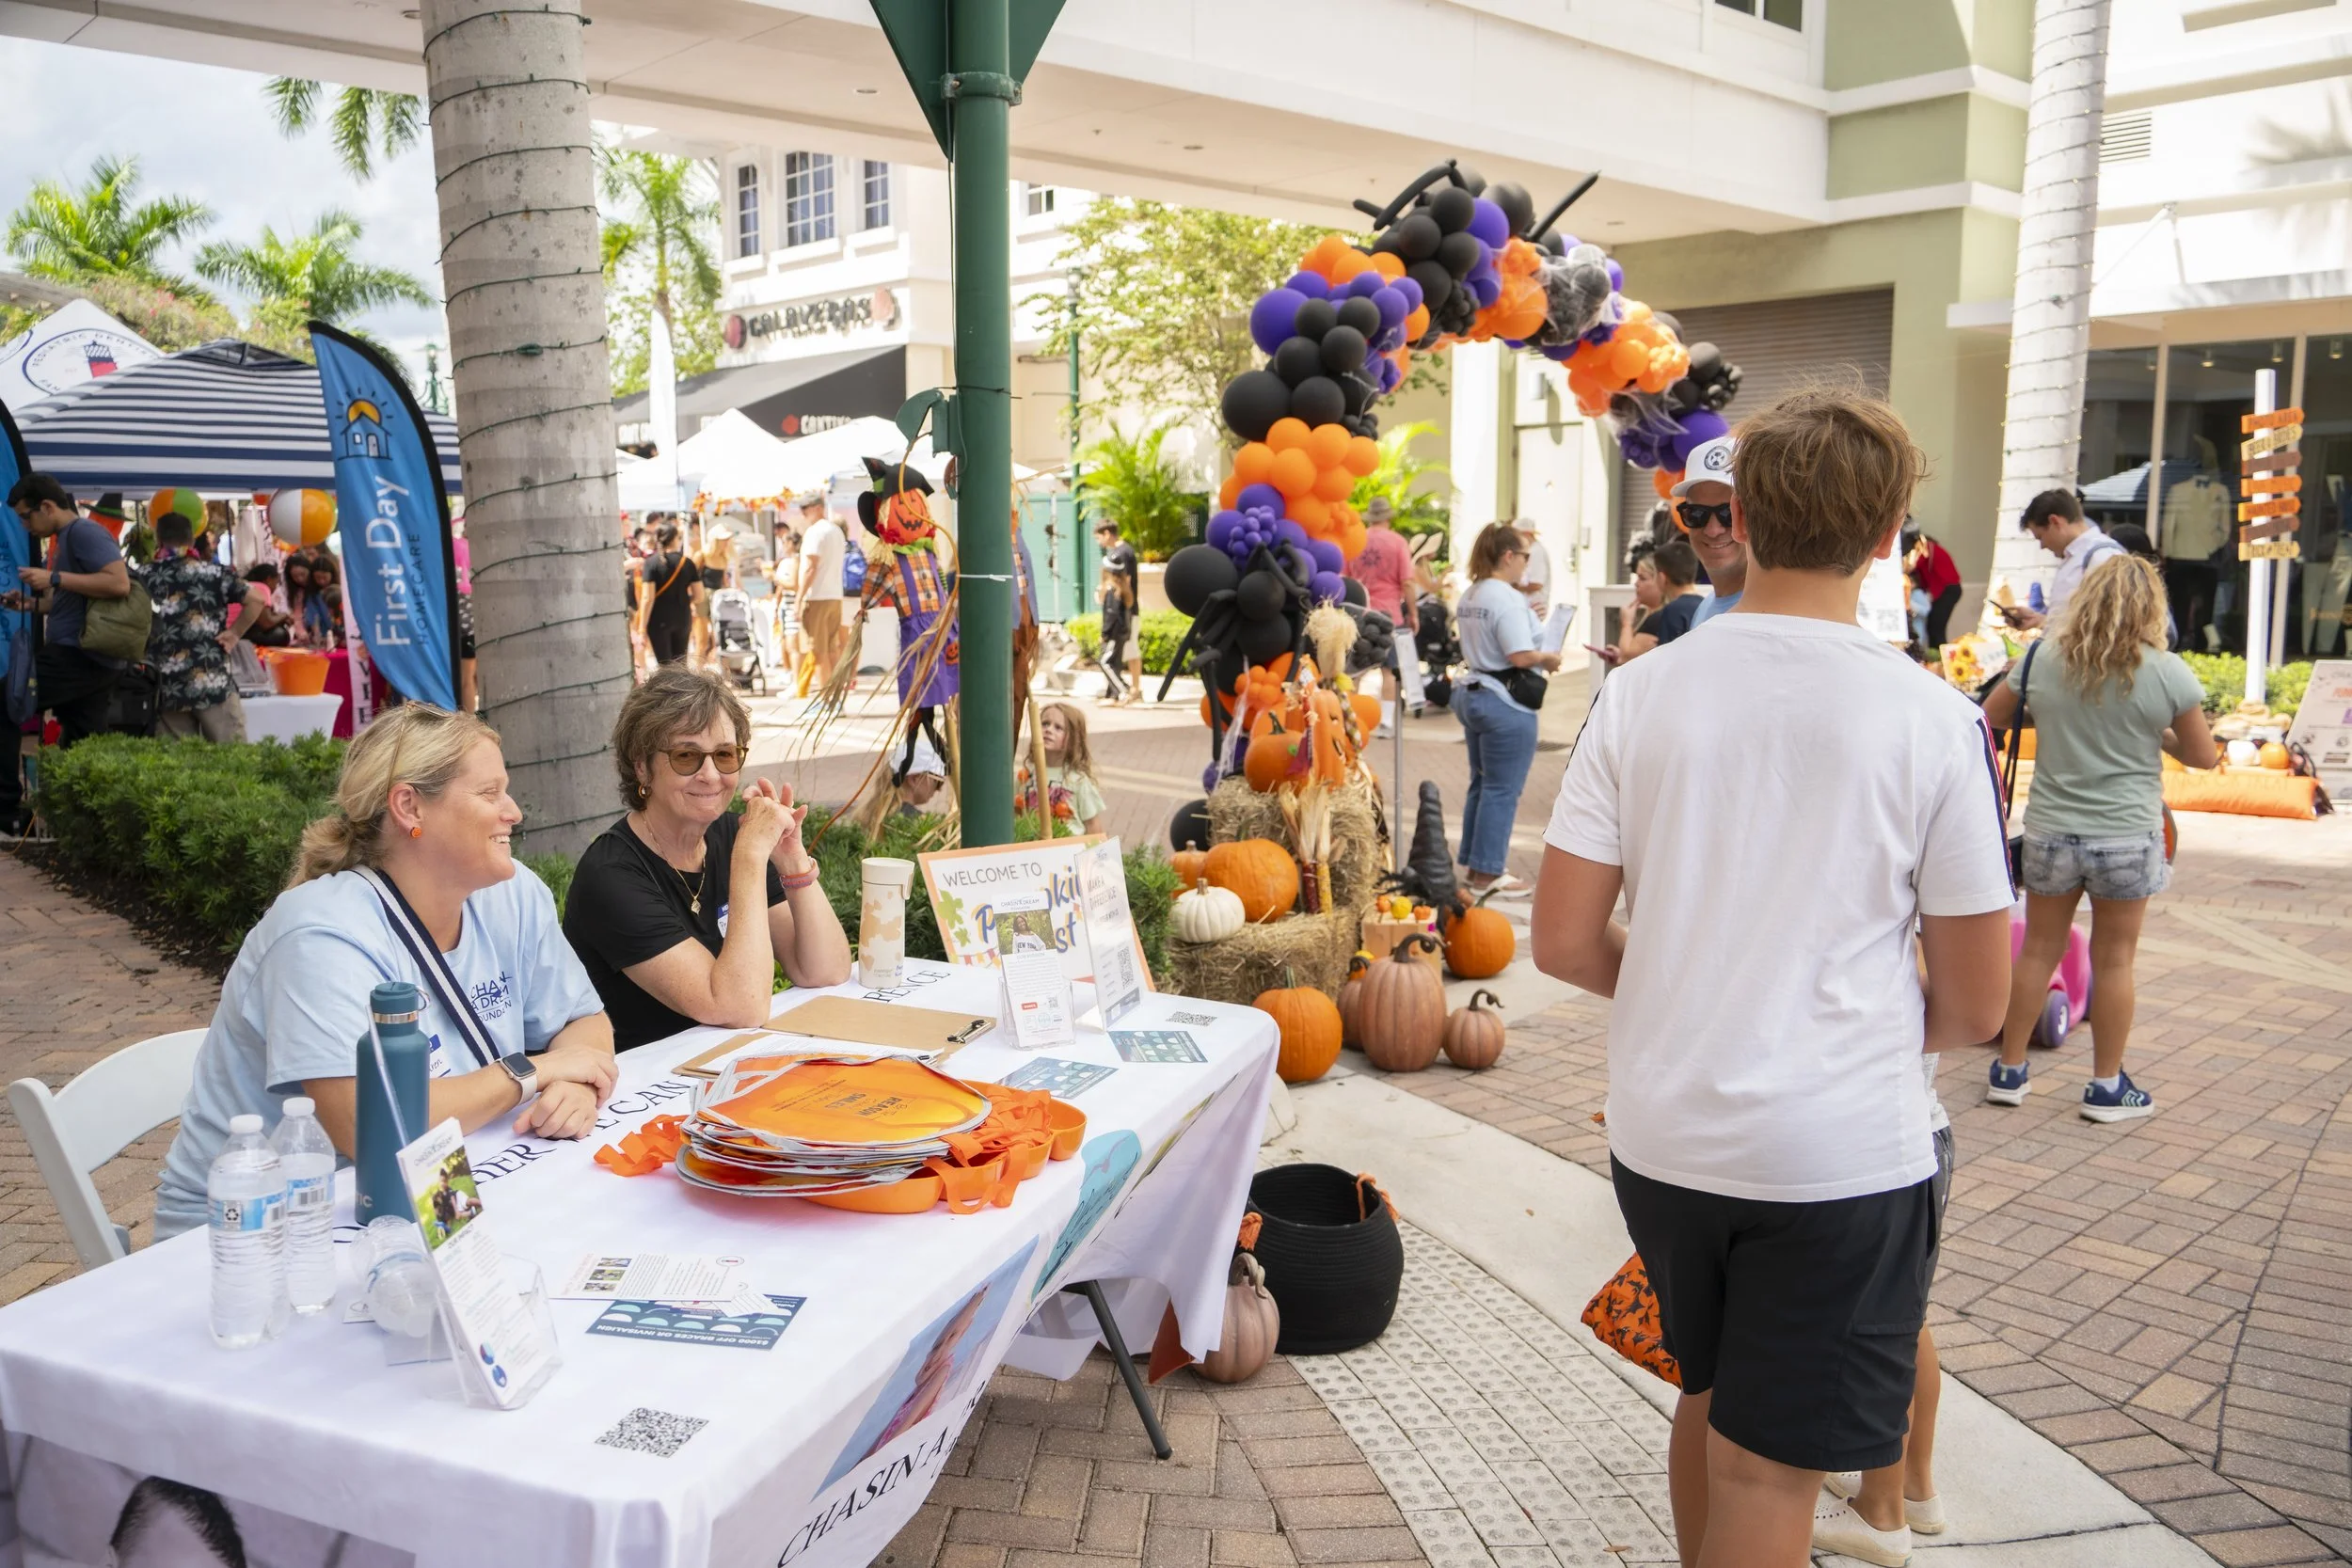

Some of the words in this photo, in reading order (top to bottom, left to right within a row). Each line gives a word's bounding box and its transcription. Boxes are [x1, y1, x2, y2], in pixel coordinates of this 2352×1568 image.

[366, 475, 410, 549] Day
[407, 532, 430, 645] HOMECARE
[376, 562, 411, 646] First
[943, 864, 1019, 887] WELCOME
[1021, 862, 1042, 878] TO
[608, 1080, 691, 1115] CAN
[596, 1323, 657, 1338] INVISALIGN
[658, 1330, 672, 1339] OR
[674, 1333, 714, 1343] BRACES
[715, 1336, 737, 1344] OFF
[738, 1338, 770, 1346] $1000
[777, 1441, 928, 1568] CHASIN
[919, 1426, 949, 1468] A
